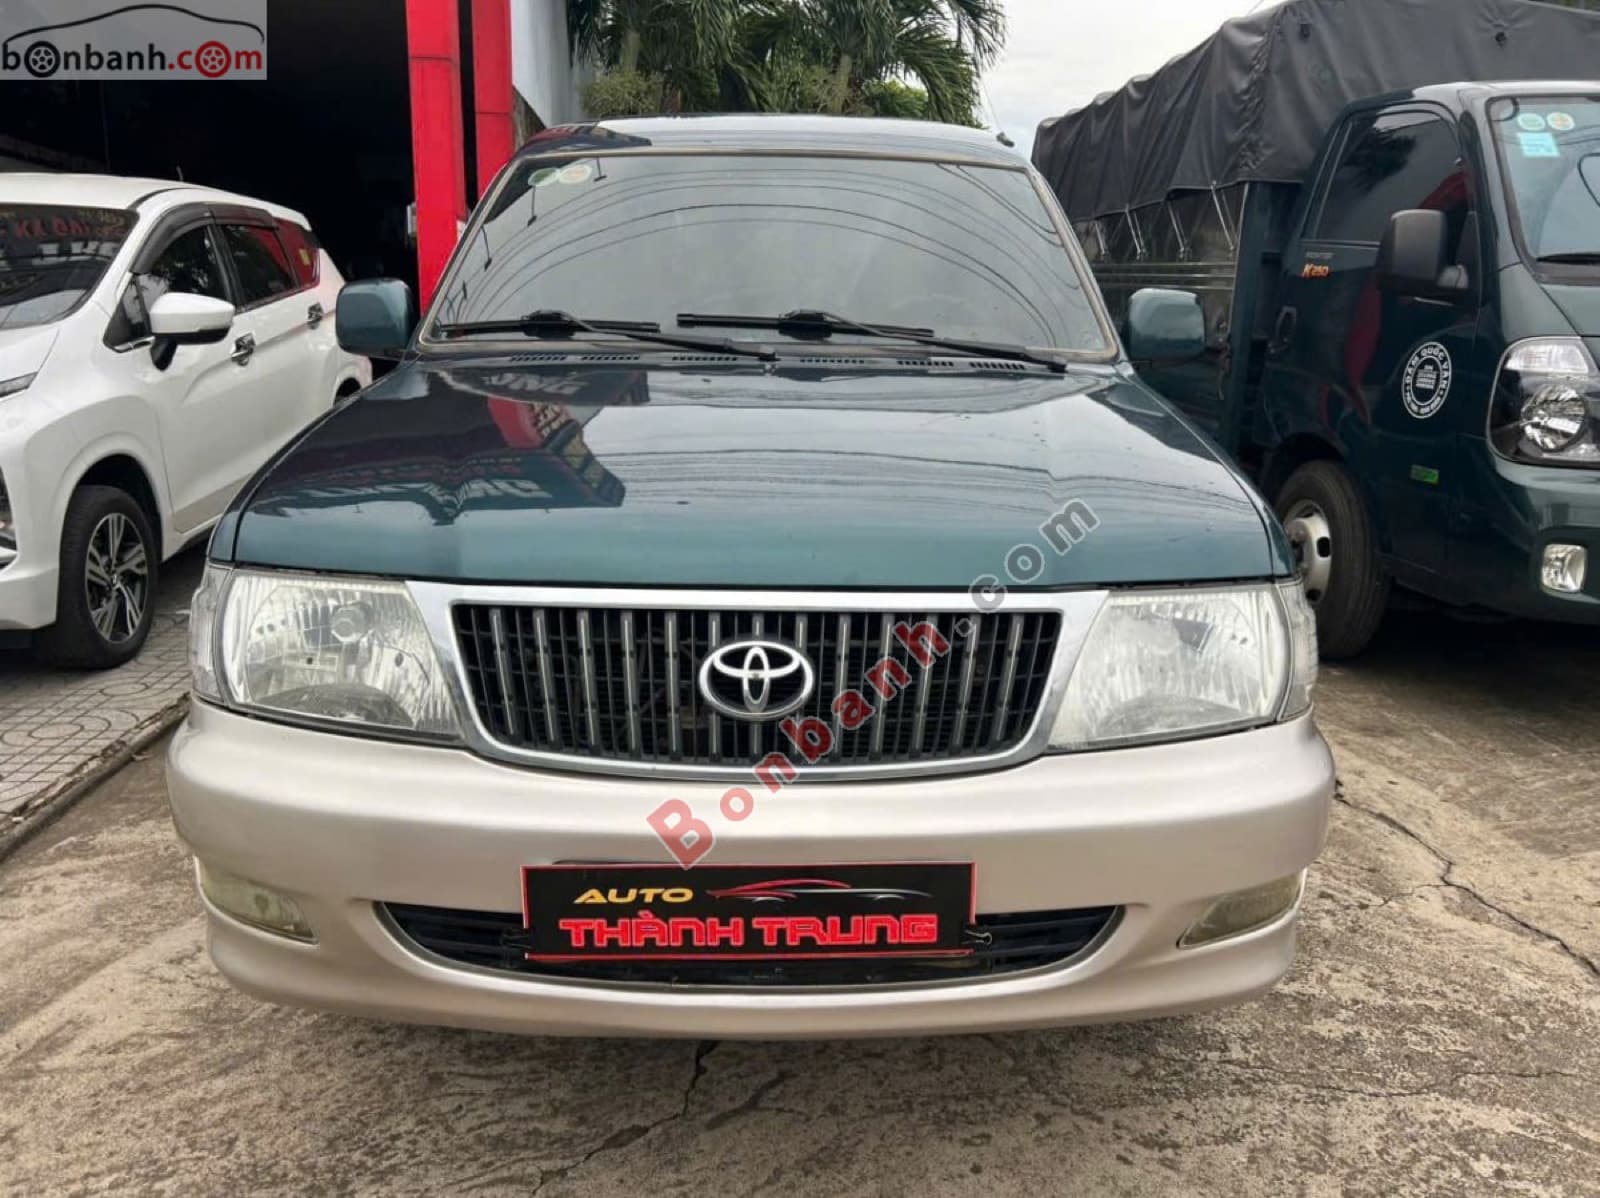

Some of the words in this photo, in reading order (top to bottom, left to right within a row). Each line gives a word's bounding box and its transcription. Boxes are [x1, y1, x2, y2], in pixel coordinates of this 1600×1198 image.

[573, 888, 694, 904] AUTO
[558, 910, 744, 948] THÀNH
[752, 914, 938, 946] TRUNG
